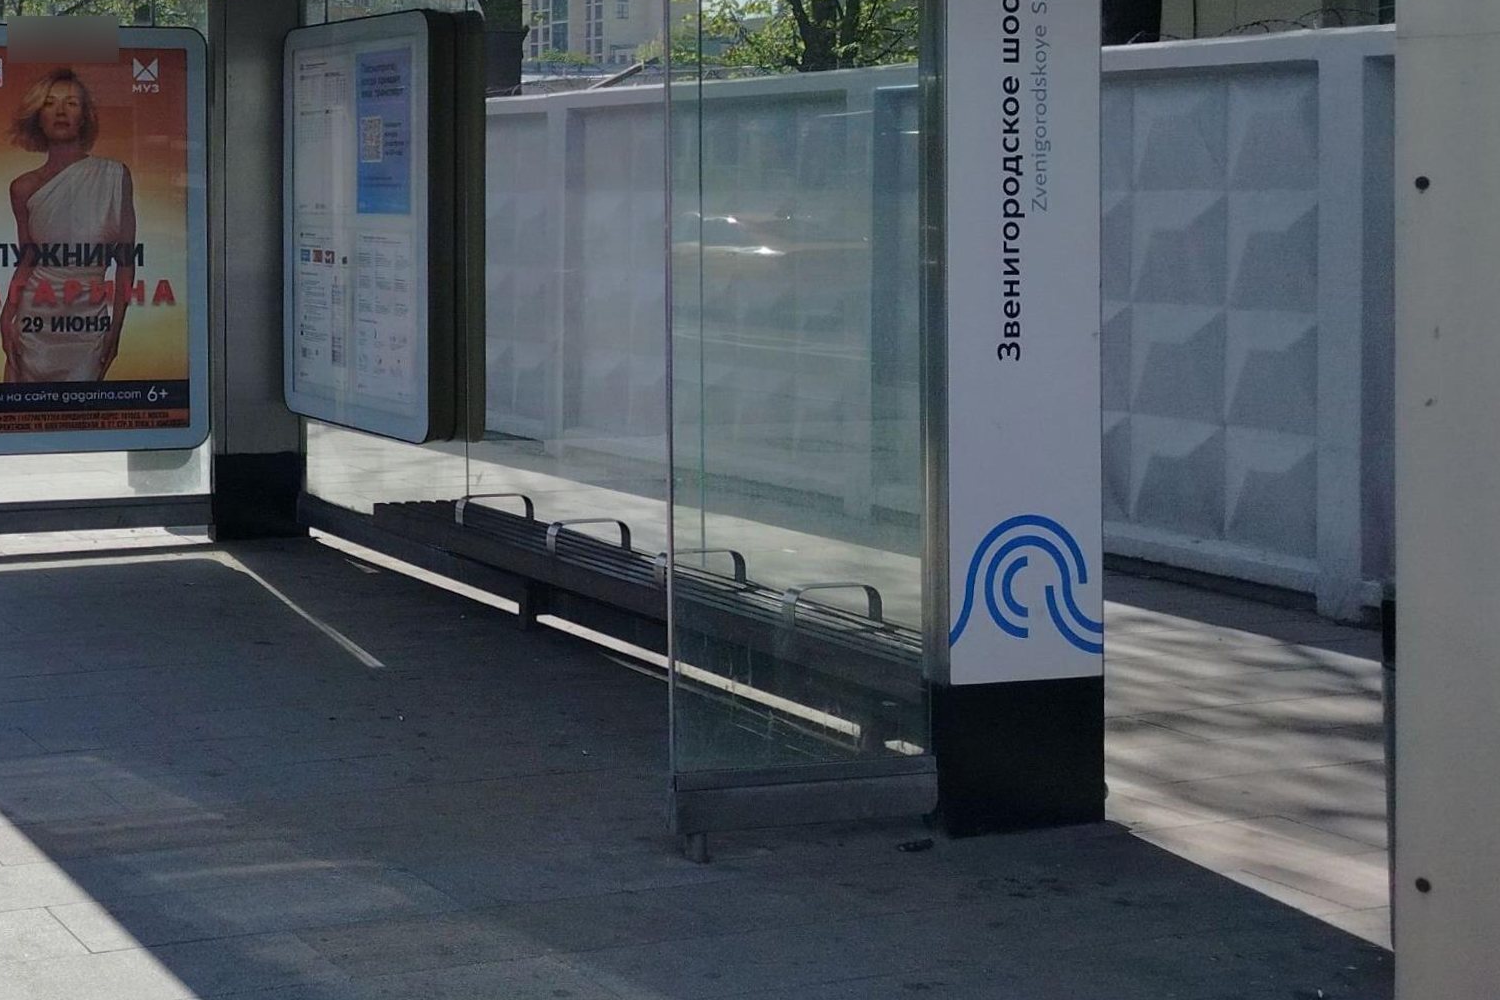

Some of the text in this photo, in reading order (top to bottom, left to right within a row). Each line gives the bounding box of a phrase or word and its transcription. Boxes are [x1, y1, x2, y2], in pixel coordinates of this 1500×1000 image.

[132, 84, 160, 94] МУЗ
[1030, 24, 1051, 213] Zvenigorodskoye
[997, 75, 1025, 361] Звенигородское
[21, 315, 111, 333] 29 ИЮНЯ
[7, 393, 21, 402] на
[24, 390, 59, 402] сайте
[62, 389, 142, 404] gagarina.com
[147, 385, 169, 402] 6+
